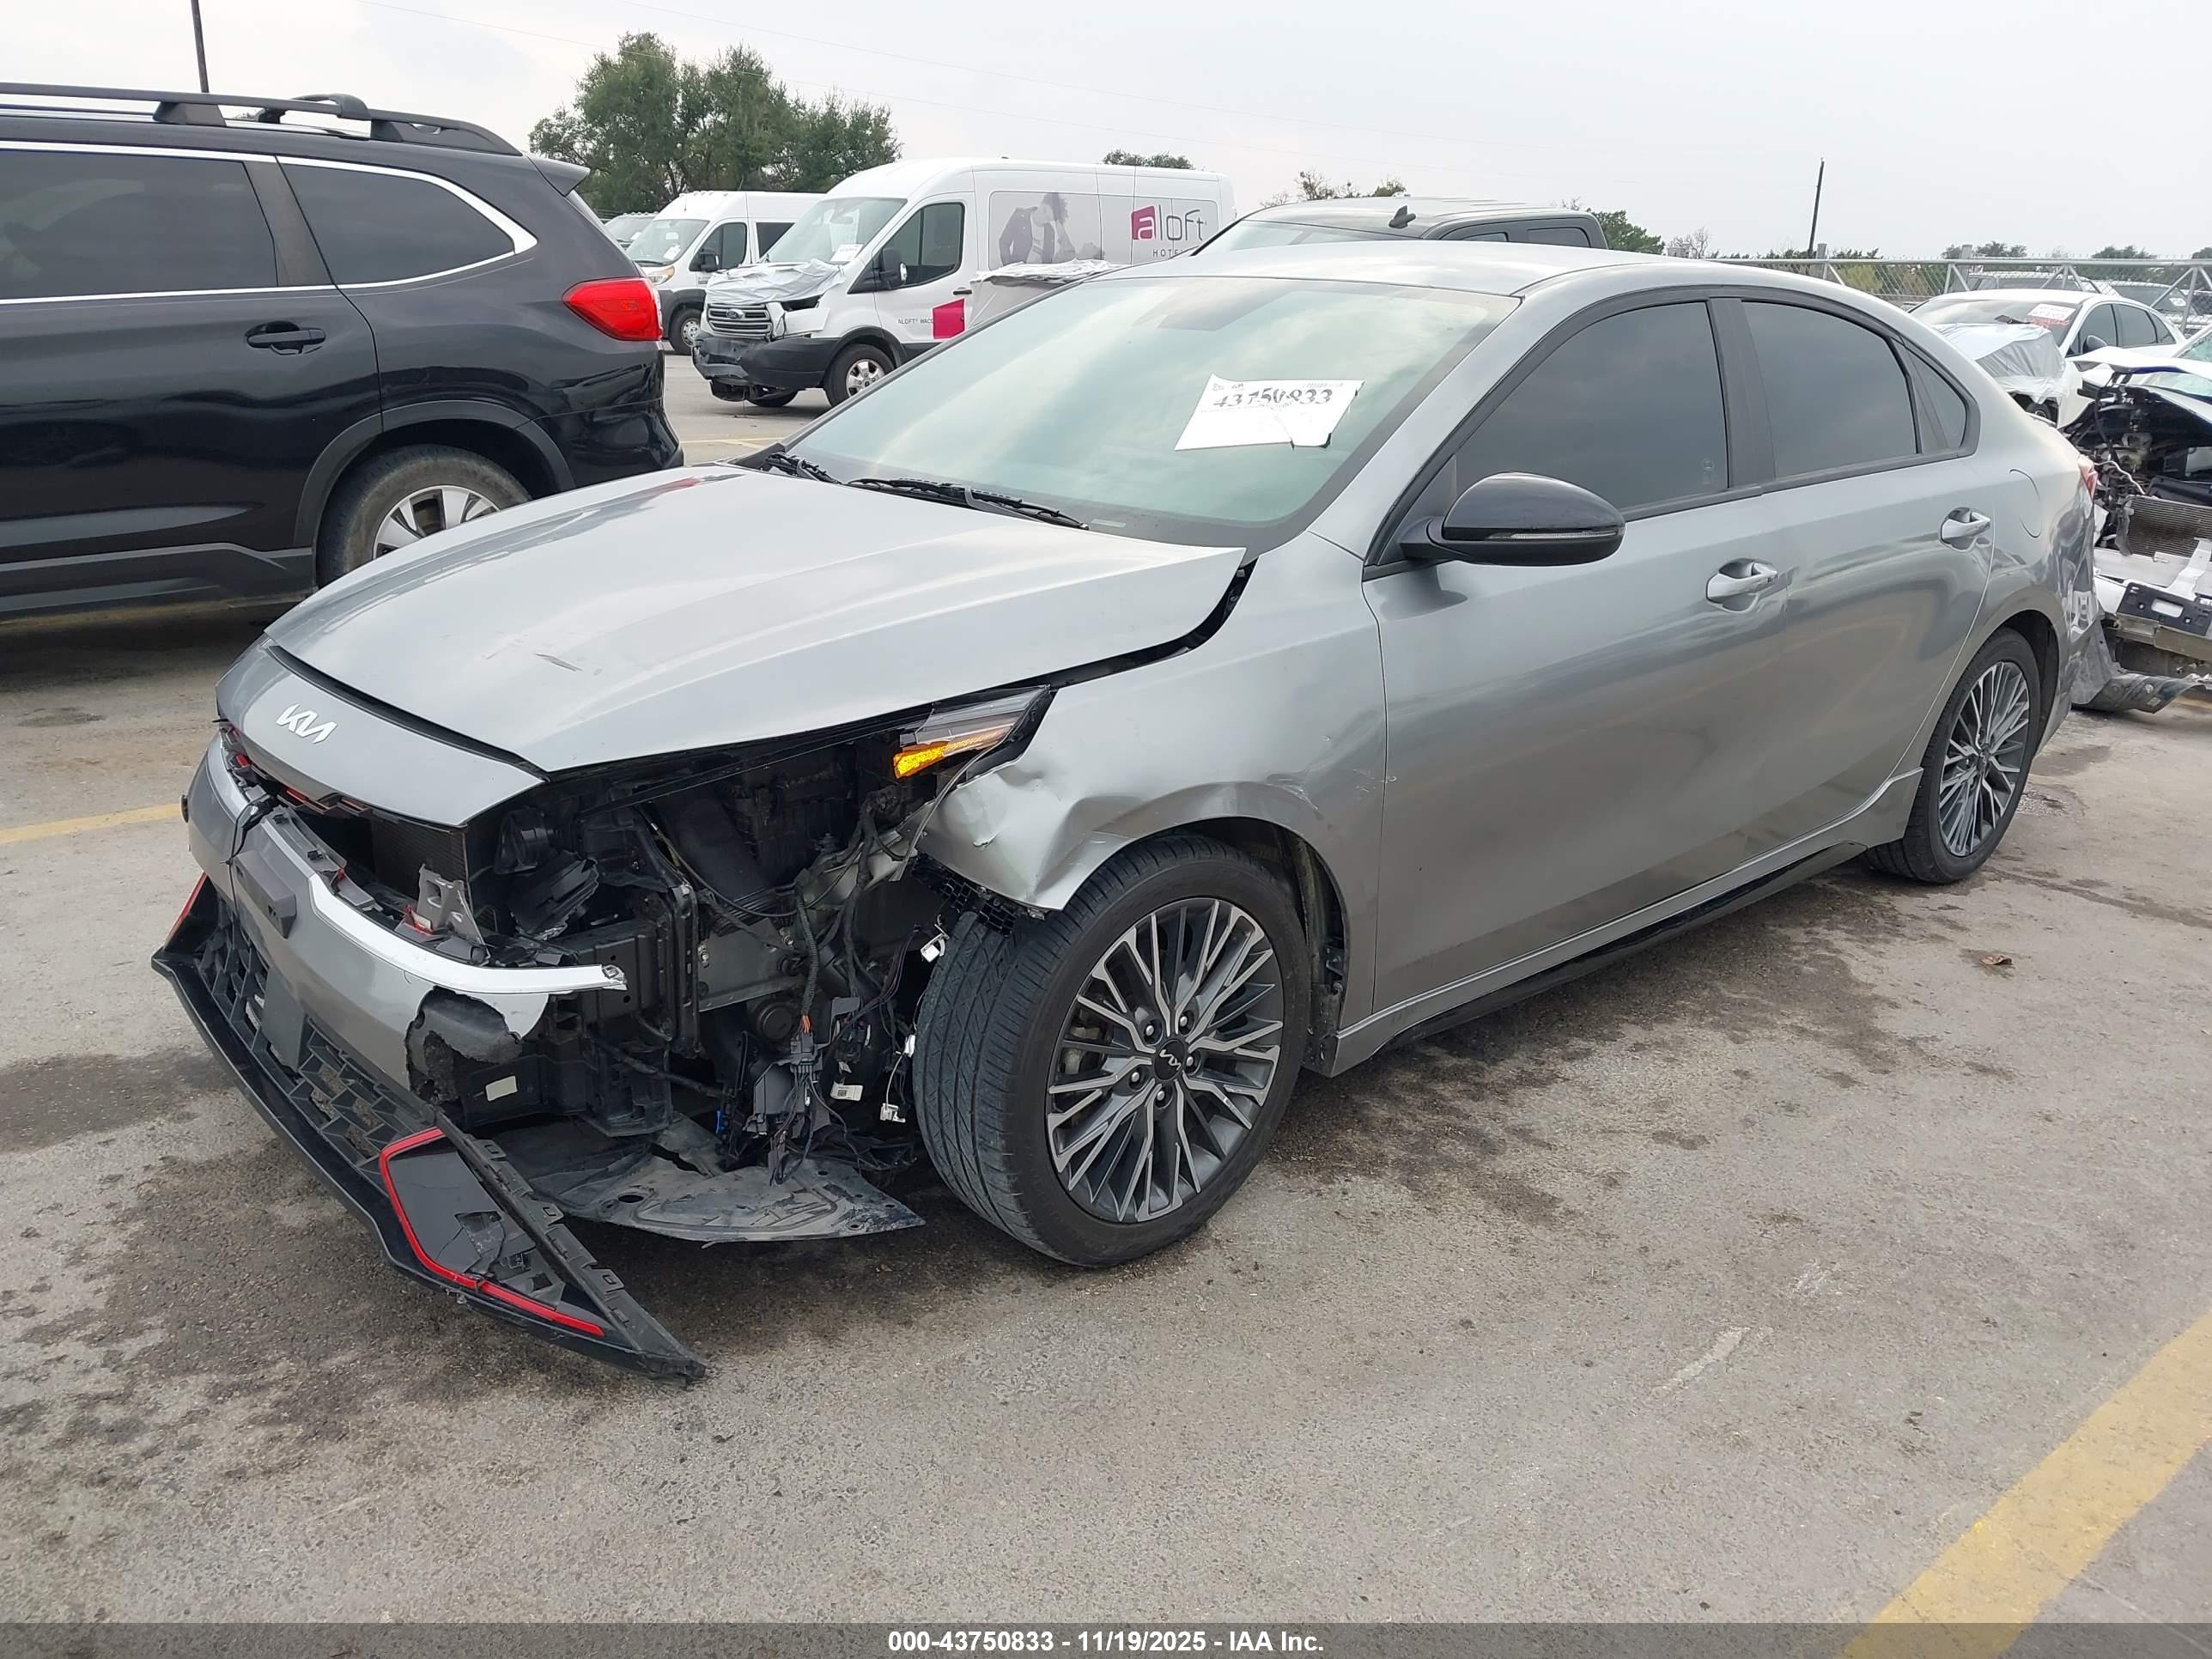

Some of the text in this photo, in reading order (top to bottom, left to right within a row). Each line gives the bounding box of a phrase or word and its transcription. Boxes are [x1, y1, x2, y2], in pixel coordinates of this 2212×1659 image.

[1132, 204, 1204, 241] aloft
[1152, 248, 1182, 258] HOTE
[275, 702, 338, 744] KIA
